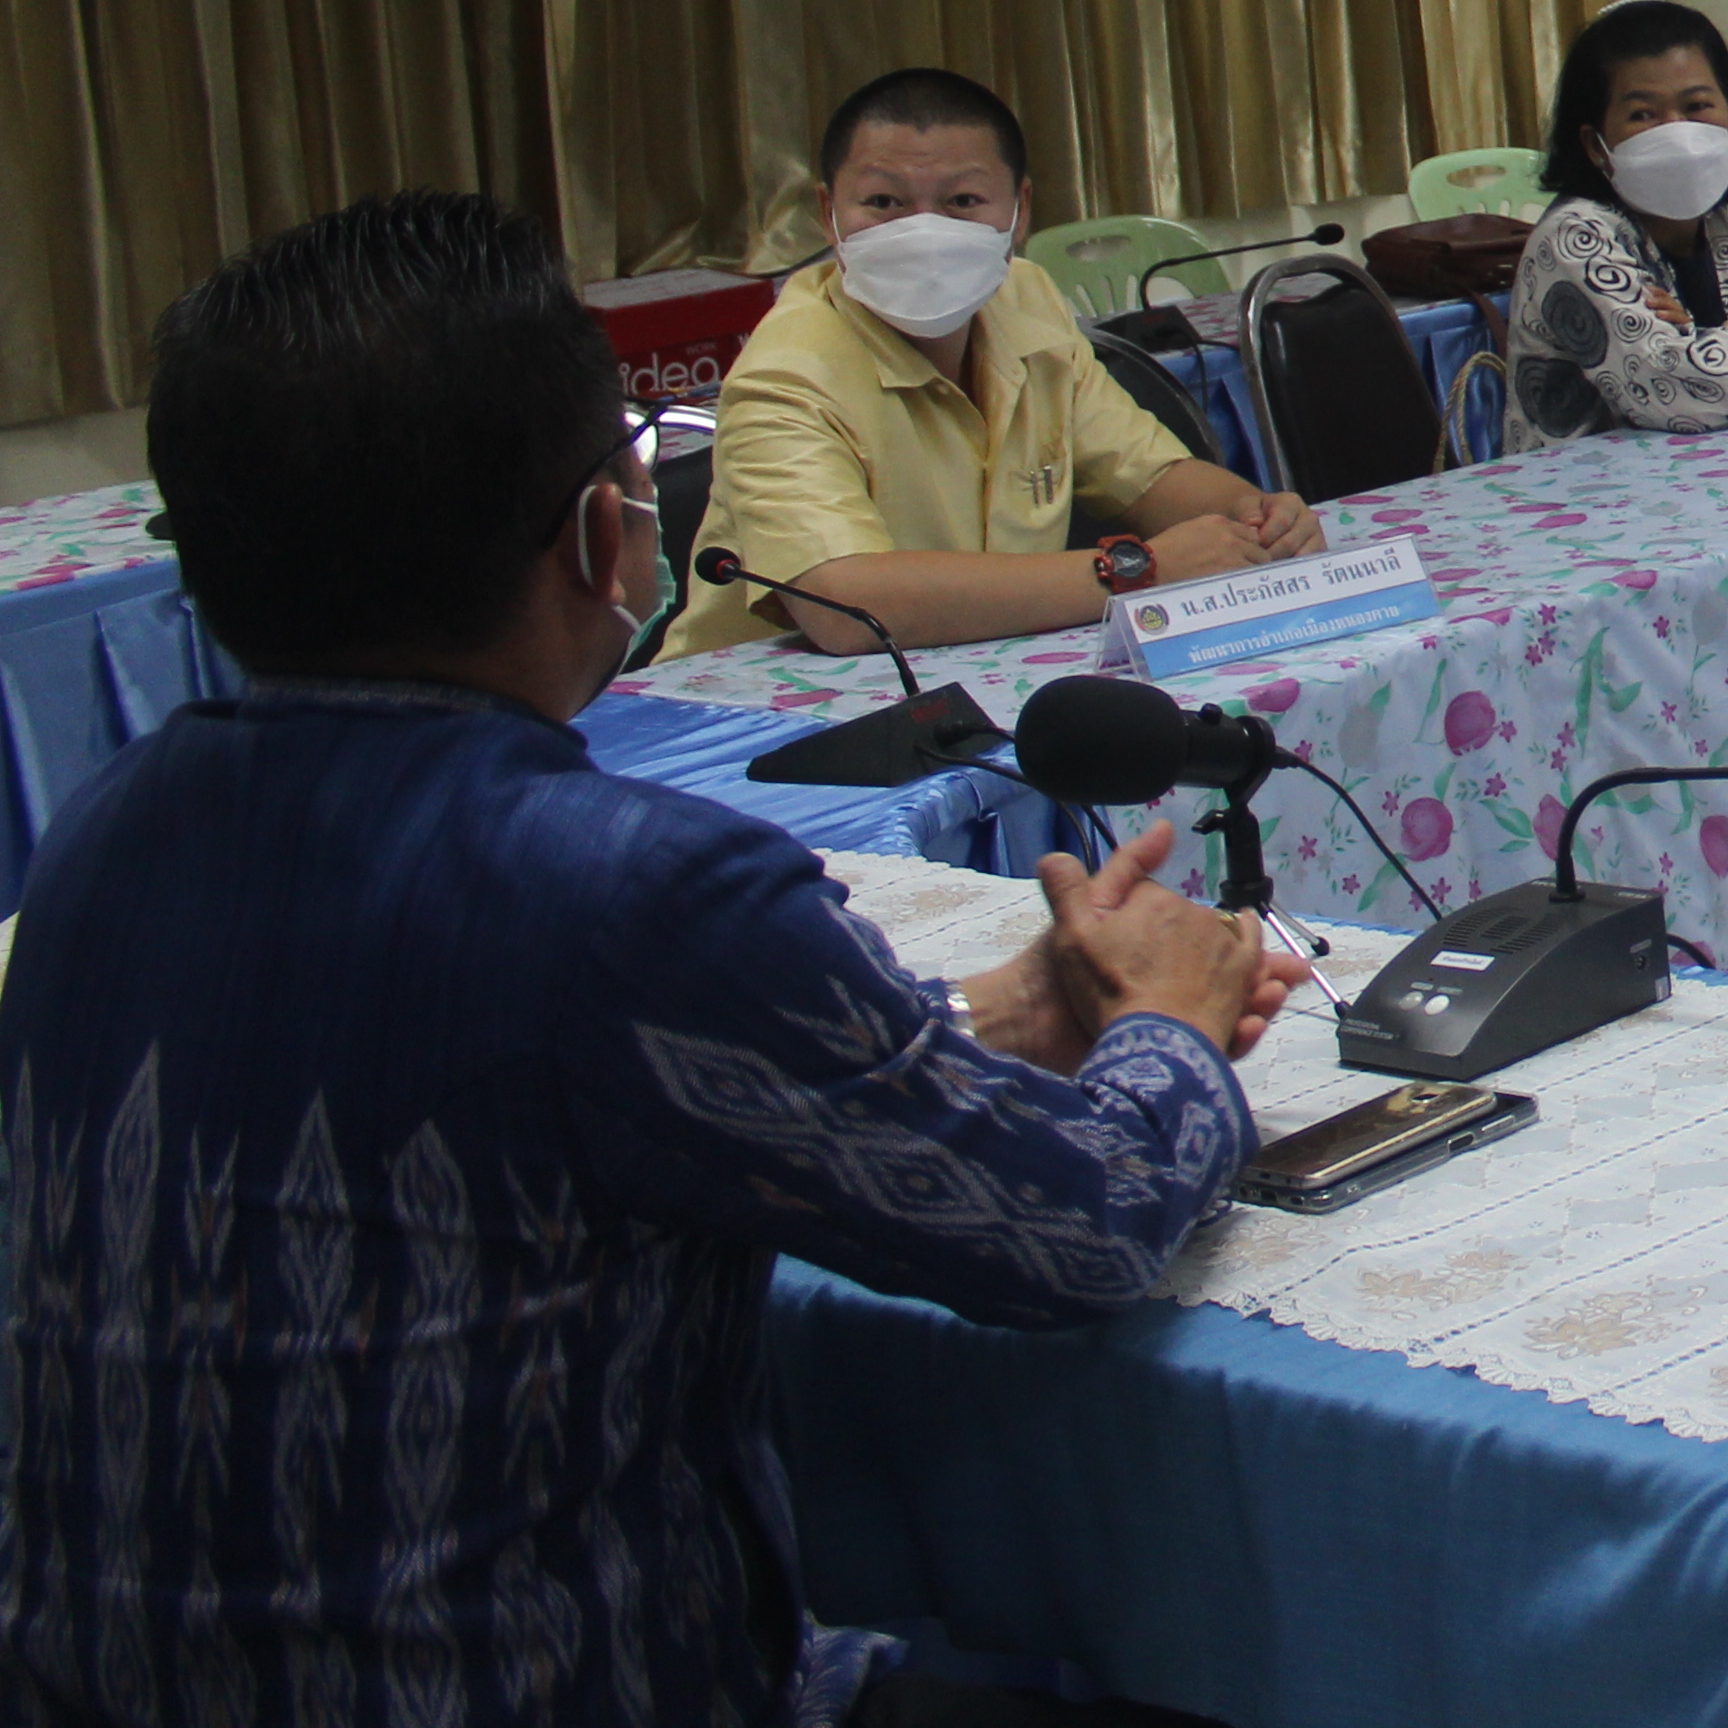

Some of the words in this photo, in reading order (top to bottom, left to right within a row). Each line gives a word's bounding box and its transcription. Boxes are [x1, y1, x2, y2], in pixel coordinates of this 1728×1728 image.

[1180, 573, 1312, 618] น.ส.ประภัสสร
[1322, 546, 1403, 587] รัตนนาลี
[1187, 603, 1400, 665] พัฒนาการอำเภอเมืองหนองคาย
